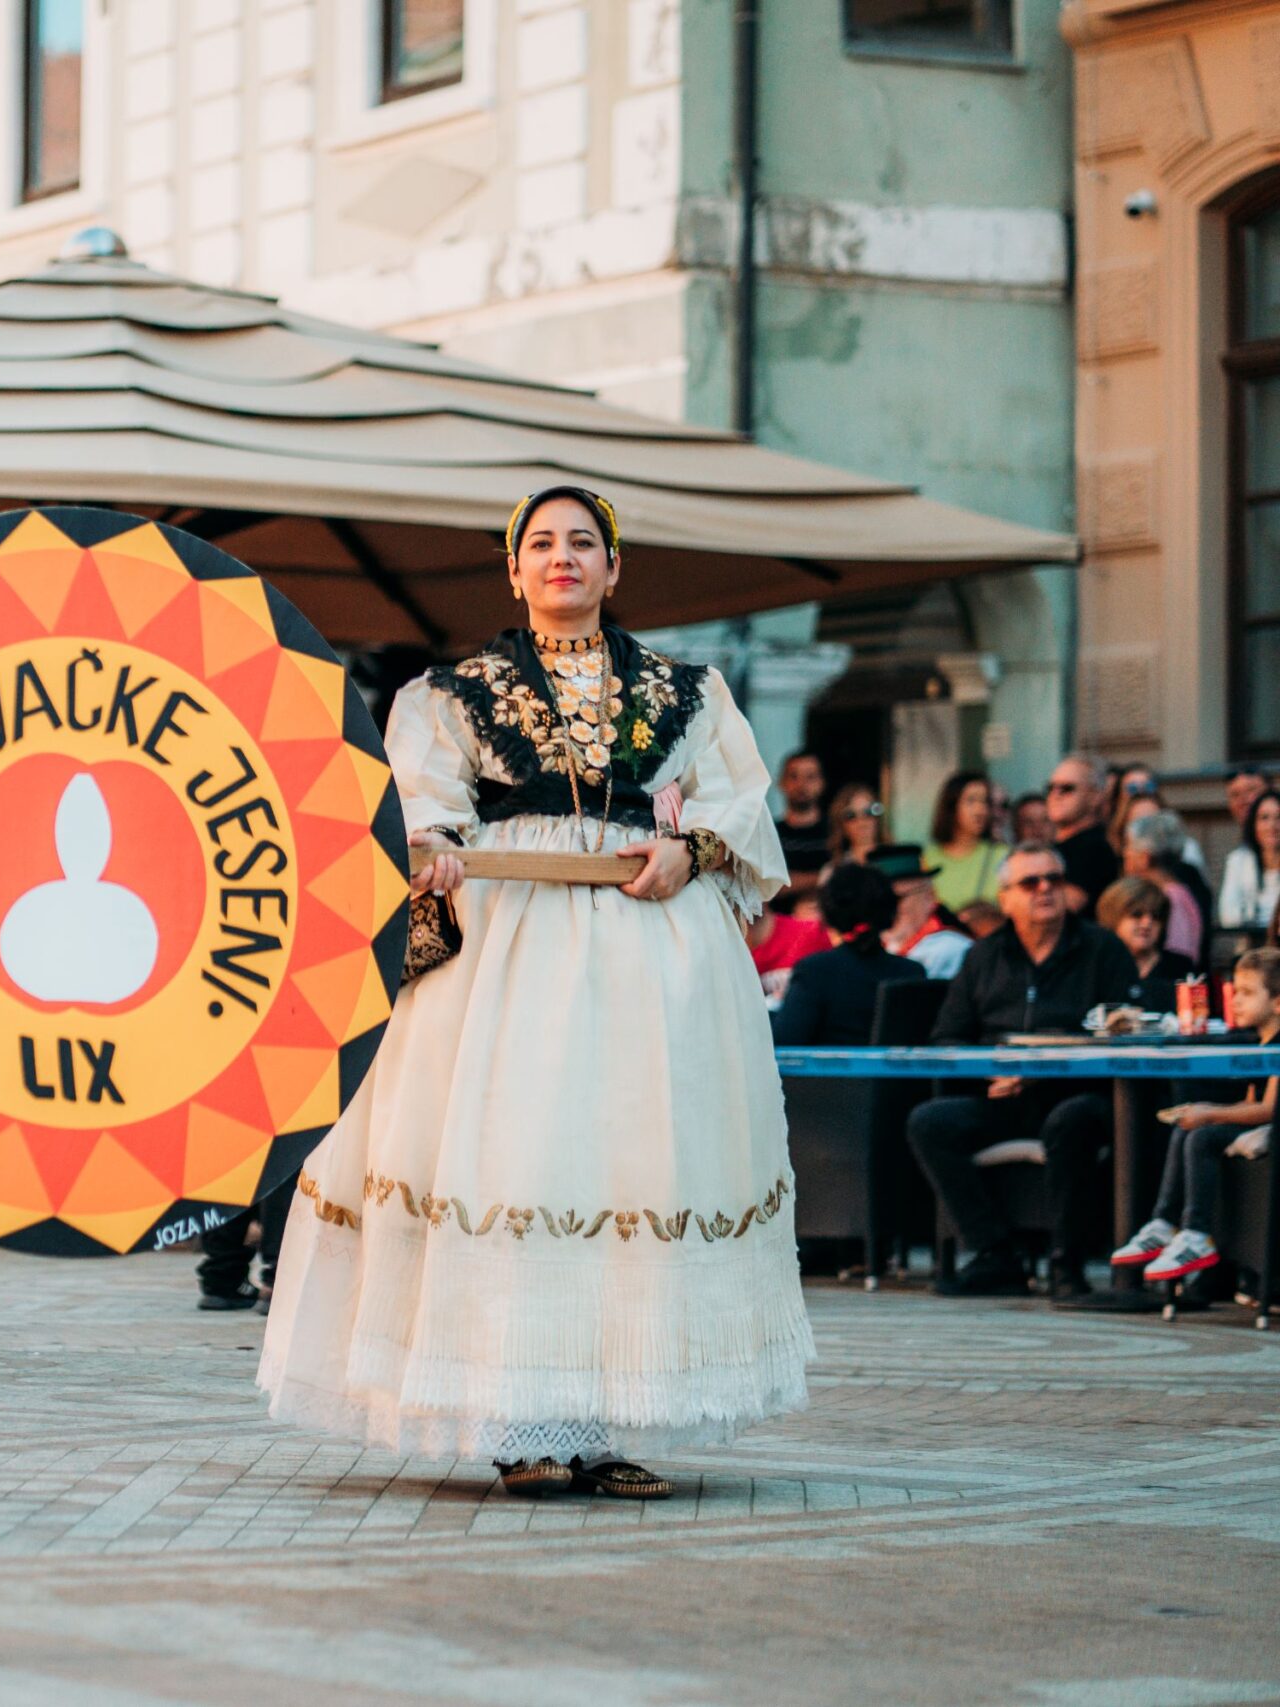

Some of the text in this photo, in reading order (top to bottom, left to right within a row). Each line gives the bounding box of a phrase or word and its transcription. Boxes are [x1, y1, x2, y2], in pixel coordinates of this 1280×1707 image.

[186, 746, 288, 1014] JESENI
[20, 1035, 125, 1105] LIX
[153, 1207, 226, 1251] JOZA M.
